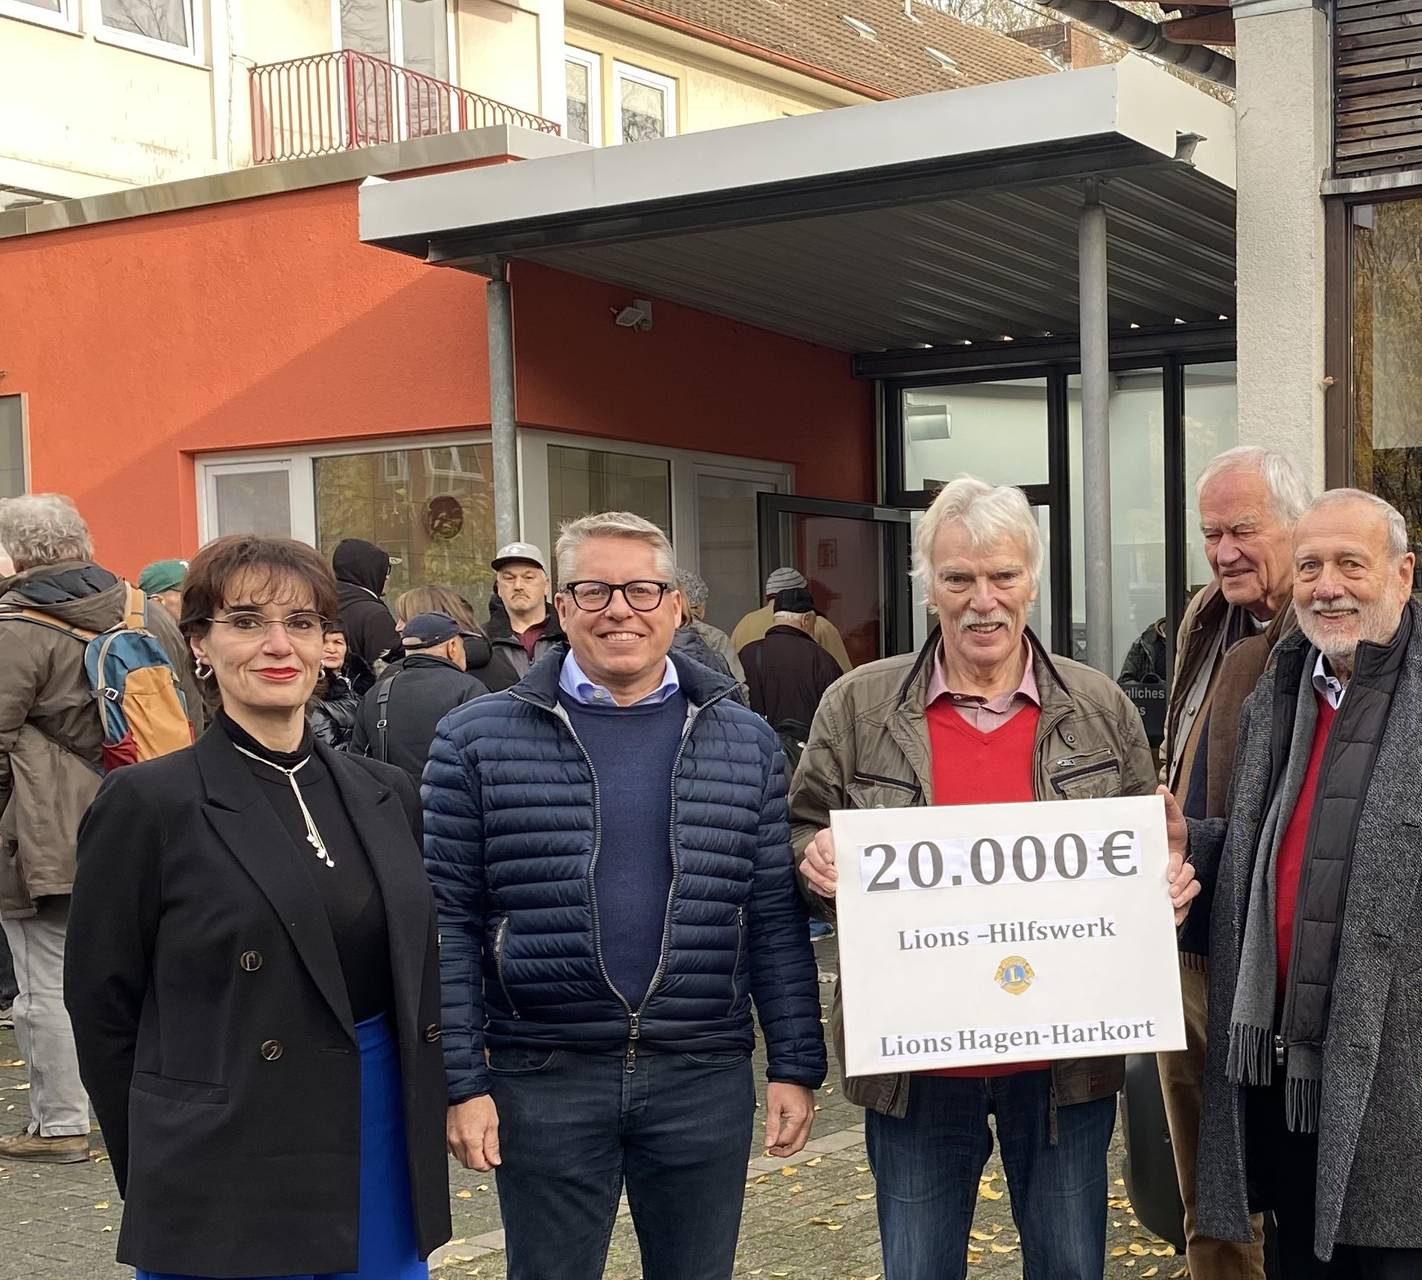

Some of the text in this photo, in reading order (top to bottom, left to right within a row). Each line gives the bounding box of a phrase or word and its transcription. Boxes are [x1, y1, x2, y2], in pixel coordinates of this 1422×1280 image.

[897, 929, 969, 951] Lions
[880, 1018, 1156, 1057] Lions Hagen-Harkort
